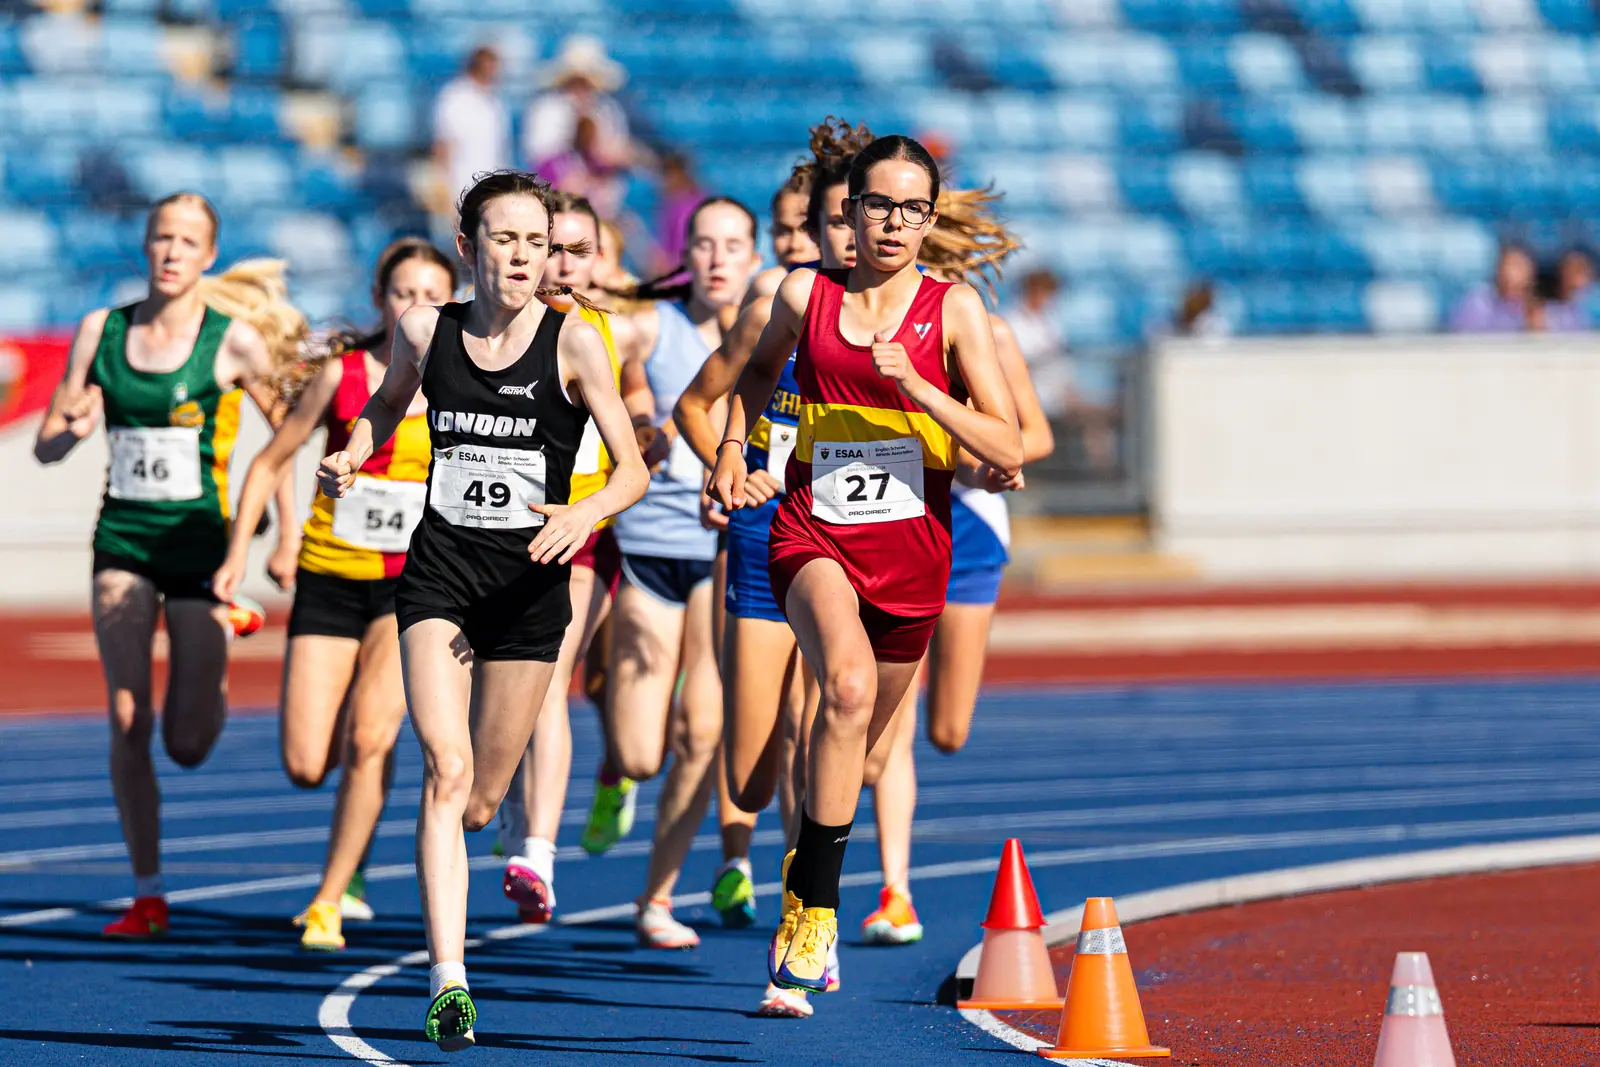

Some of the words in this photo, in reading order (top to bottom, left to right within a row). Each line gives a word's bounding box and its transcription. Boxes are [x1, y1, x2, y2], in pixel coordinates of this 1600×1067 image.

[431, 409, 537, 437] LONDON
[458, 451, 487, 463] ESAA
[835, 449, 864, 459] ESAA
[132, 459, 169, 481] 46
[463, 480, 511, 508] 49
[844, 472, 890, 502] 27
[366, 509, 404, 532] 54
